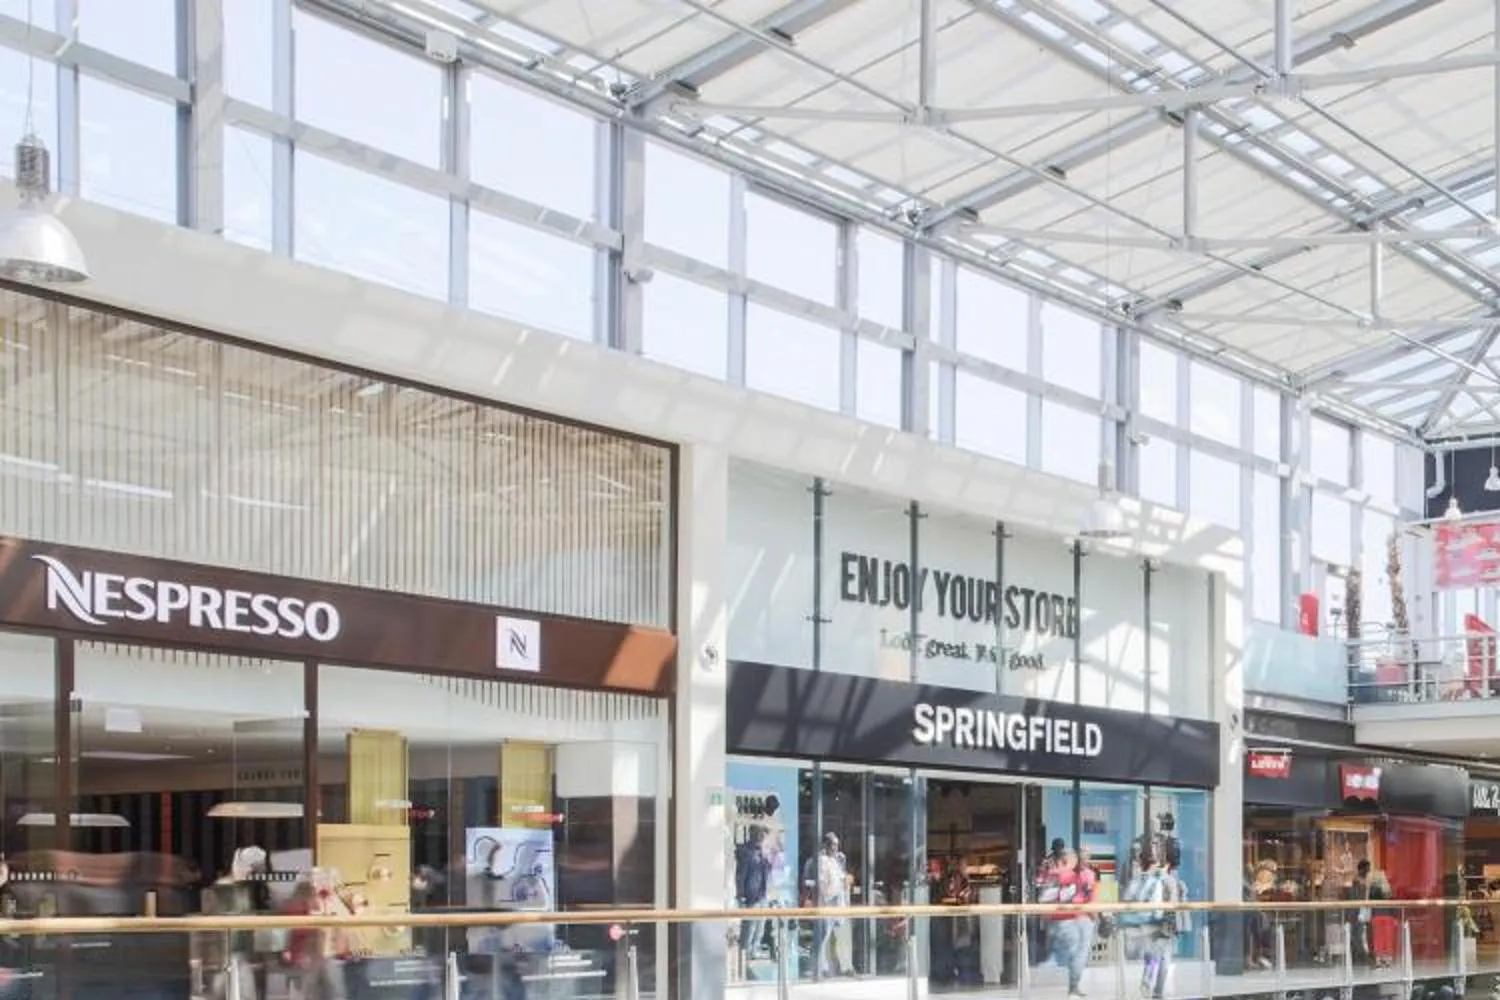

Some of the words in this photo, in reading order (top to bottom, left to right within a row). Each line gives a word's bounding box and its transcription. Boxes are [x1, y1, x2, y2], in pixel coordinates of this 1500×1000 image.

[33, 555, 341, 642] NESPRESSO
[841, 552, 928, 612] ENJOY
[933, 570, 1001, 628] YOUR
[913, 703, 1103, 757] SPRINGFIELD
